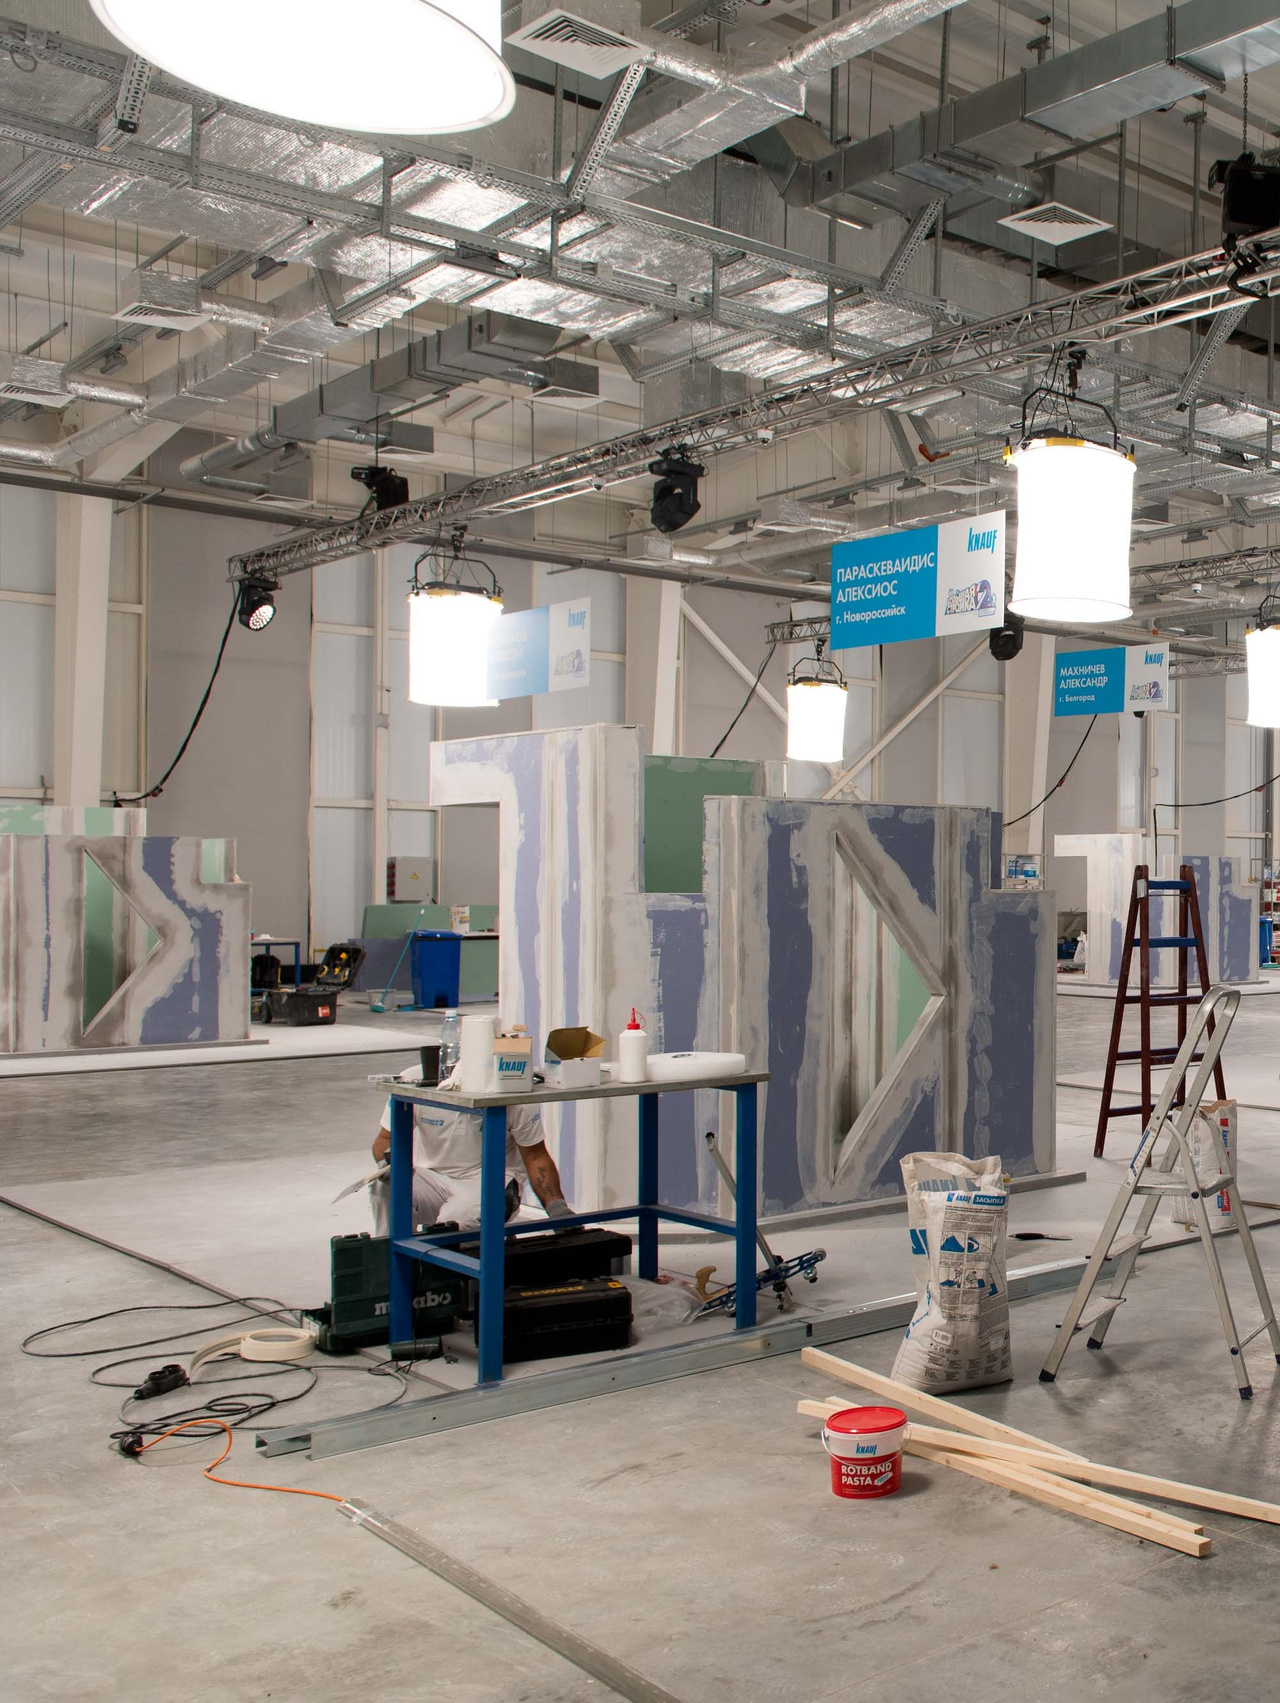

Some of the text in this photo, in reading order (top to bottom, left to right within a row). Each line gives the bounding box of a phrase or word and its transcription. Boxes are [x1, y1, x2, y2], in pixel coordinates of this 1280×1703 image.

[967, 527, 998, 553] KNAUF
[836, 552, 935, 583] ПАРАСКЕВАИДИС
[836, 580, 898, 604] АЛЕКСИОС
[836, 604, 906, 624] г. Новороссийск
[1144, 650, 1164, 667] KNAUF
[1060, 664, 1105, 676] МАХНИЧЕВ
[1059, 676, 1108, 690] АЛЕКСАНДР
[1065, 694, 1095, 703] Белгород
[498, 1057, 528, 1075] KNAUF
[374, 1291, 452, 1316] mabo
[856, 1443, 878, 1455] KNAUF
[841, 1463, 892, 1475] ROTBAND
[841, 1475, 873, 1486] PASTA
